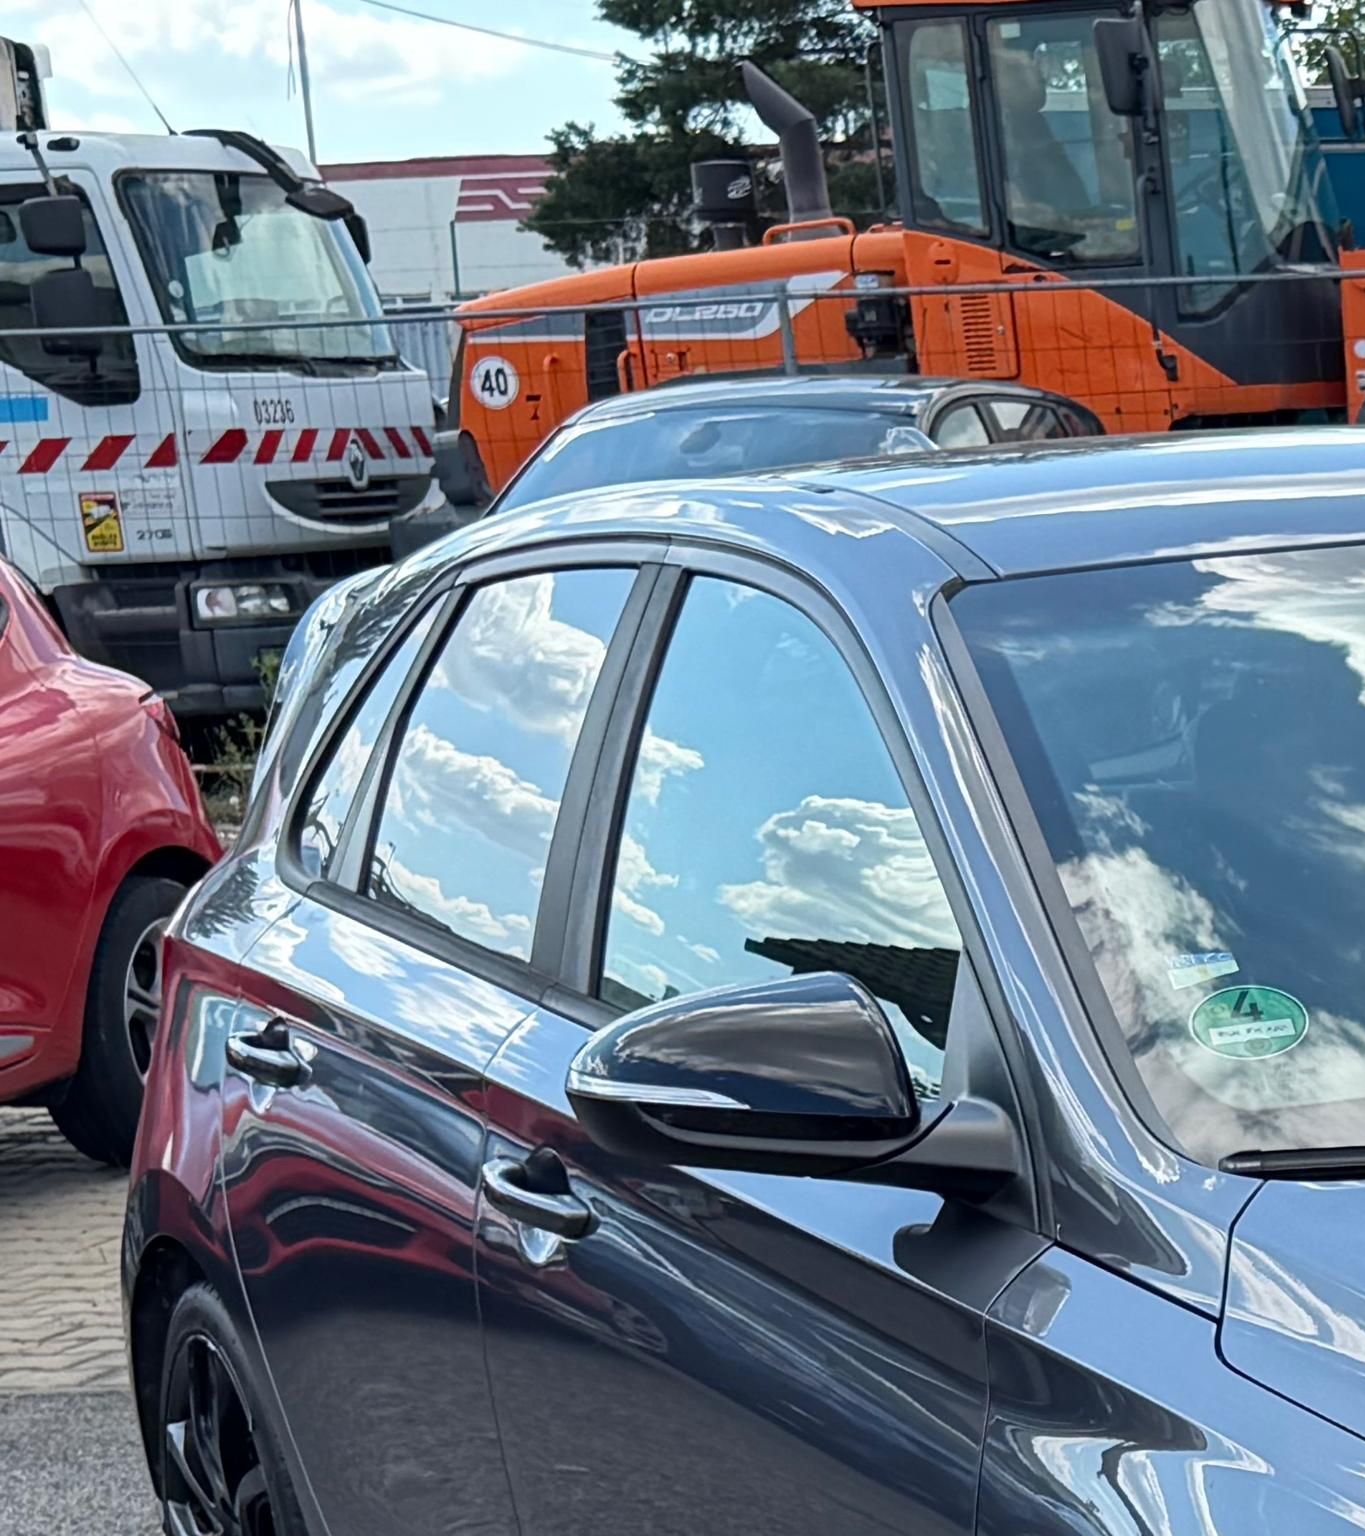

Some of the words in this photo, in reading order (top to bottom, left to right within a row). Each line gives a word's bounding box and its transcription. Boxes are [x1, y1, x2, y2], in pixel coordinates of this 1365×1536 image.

[481, 367, 508, 397] 40
[253, 398, 295, 425] 03236
[1231, 990, 1264, 1021] 4
